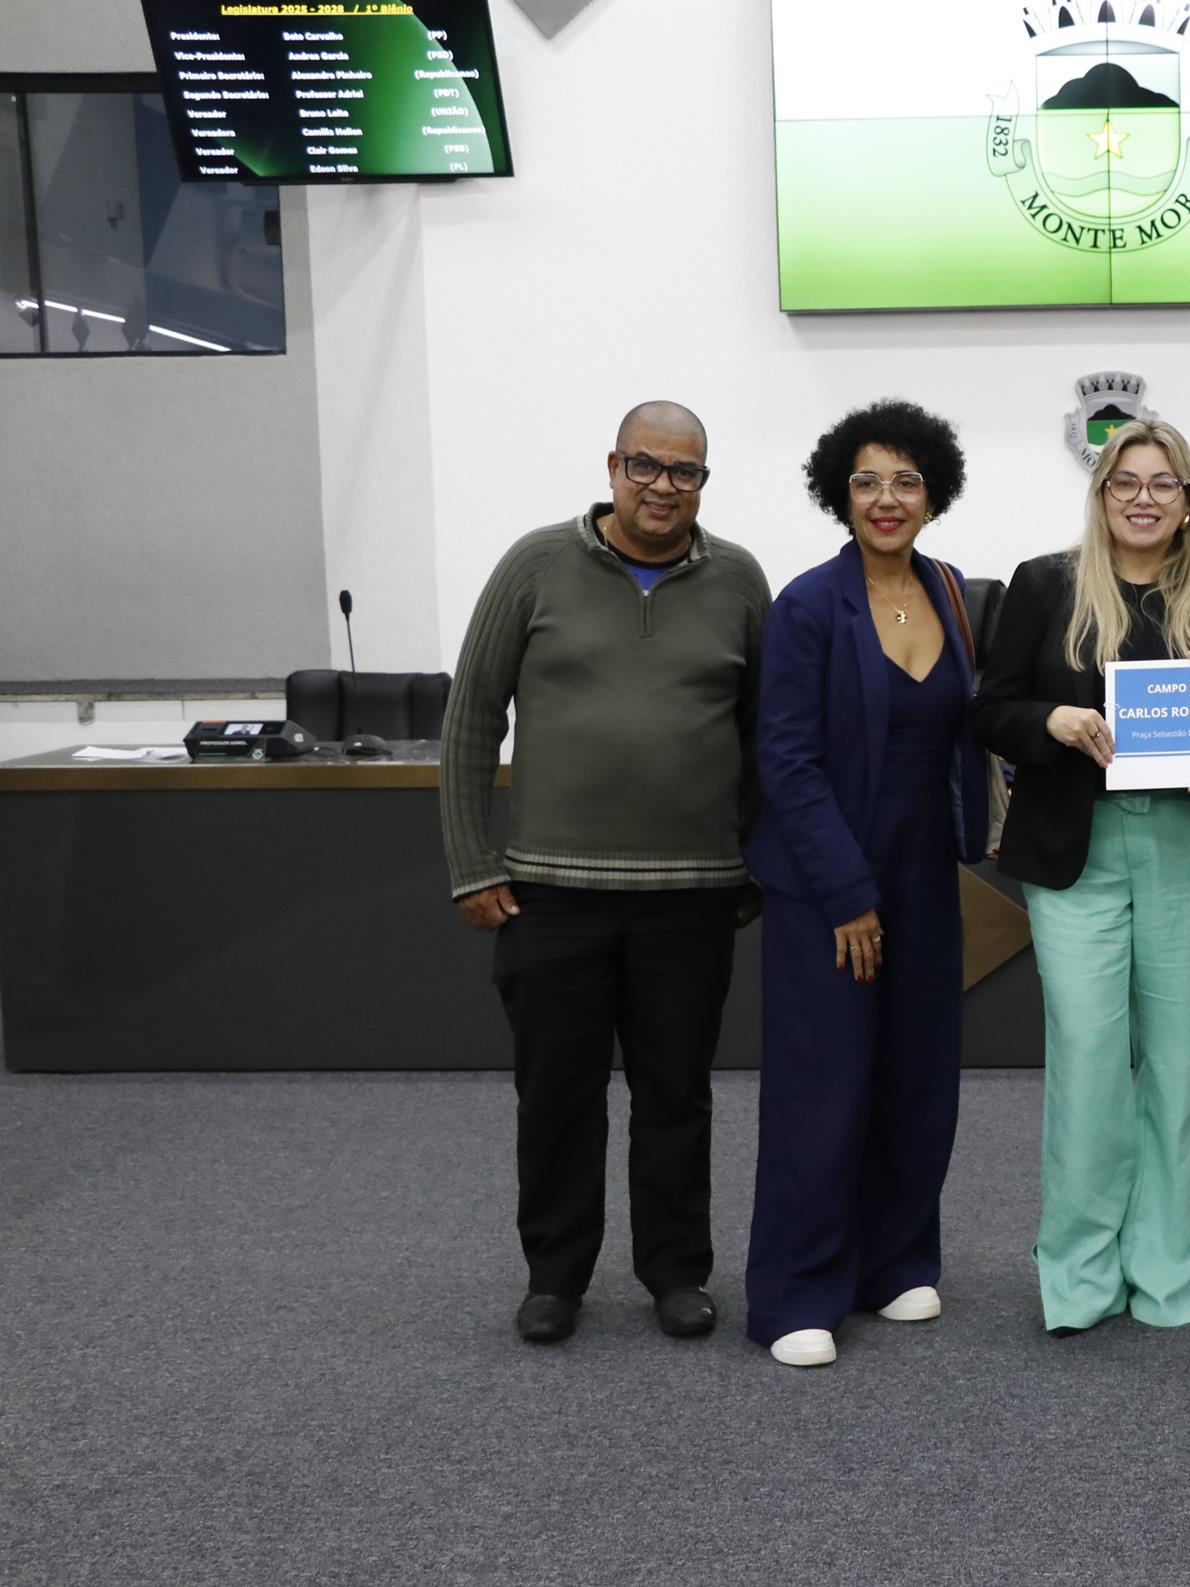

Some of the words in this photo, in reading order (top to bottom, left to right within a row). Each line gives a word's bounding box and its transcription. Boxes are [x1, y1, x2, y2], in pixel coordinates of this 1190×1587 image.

[221, 4, 278, 15] Legislatura
[281, 4, 307, 14] 2025
[318, 4, 344, 14] 2028
[381, 4, 414, 14] Biênio
[170, 31, 220, 41] Presidente:
[305, 31, 344, 41] Carvalho
[427, 30, 447, 41] (PP)
[179, 71, 217, 80] Primeiro
[336, 70, 373, 80] Pinheiro
[414, 68, 479, 80] (Republicanos)
[183, 90, 221, 100] Segundo
[295, 89, 336, 99] Professor
[434, 88, 459, 98] (PDT)
[187, 109, 227, 119] Vereador
[299, 108, 326, 118] Bruno
[431, 105, 468, 117] (UNIÃO)
[191, 128, 236, 138] Vereadora
[422, 125, 486, 136] (Republicanos)
[991, 114, 1012, 158] 1832
[195, 147, 235, 156] Vereador
[328, 146, 358, 155] Gomes
[200, 165, 239, 175] Vereador
[309, 164, 336, 174] Edson
[337, 164, 359, 174] Silva
[1020, 191, 1128, 250] MONTE
[1147, 683, 1187, 694] CAMPO
[1119, 707, 1168, 719] CARLOS
[1132, 730, 1151, 739] Praça
[1153, 727, 1187, 738] Sebastião
